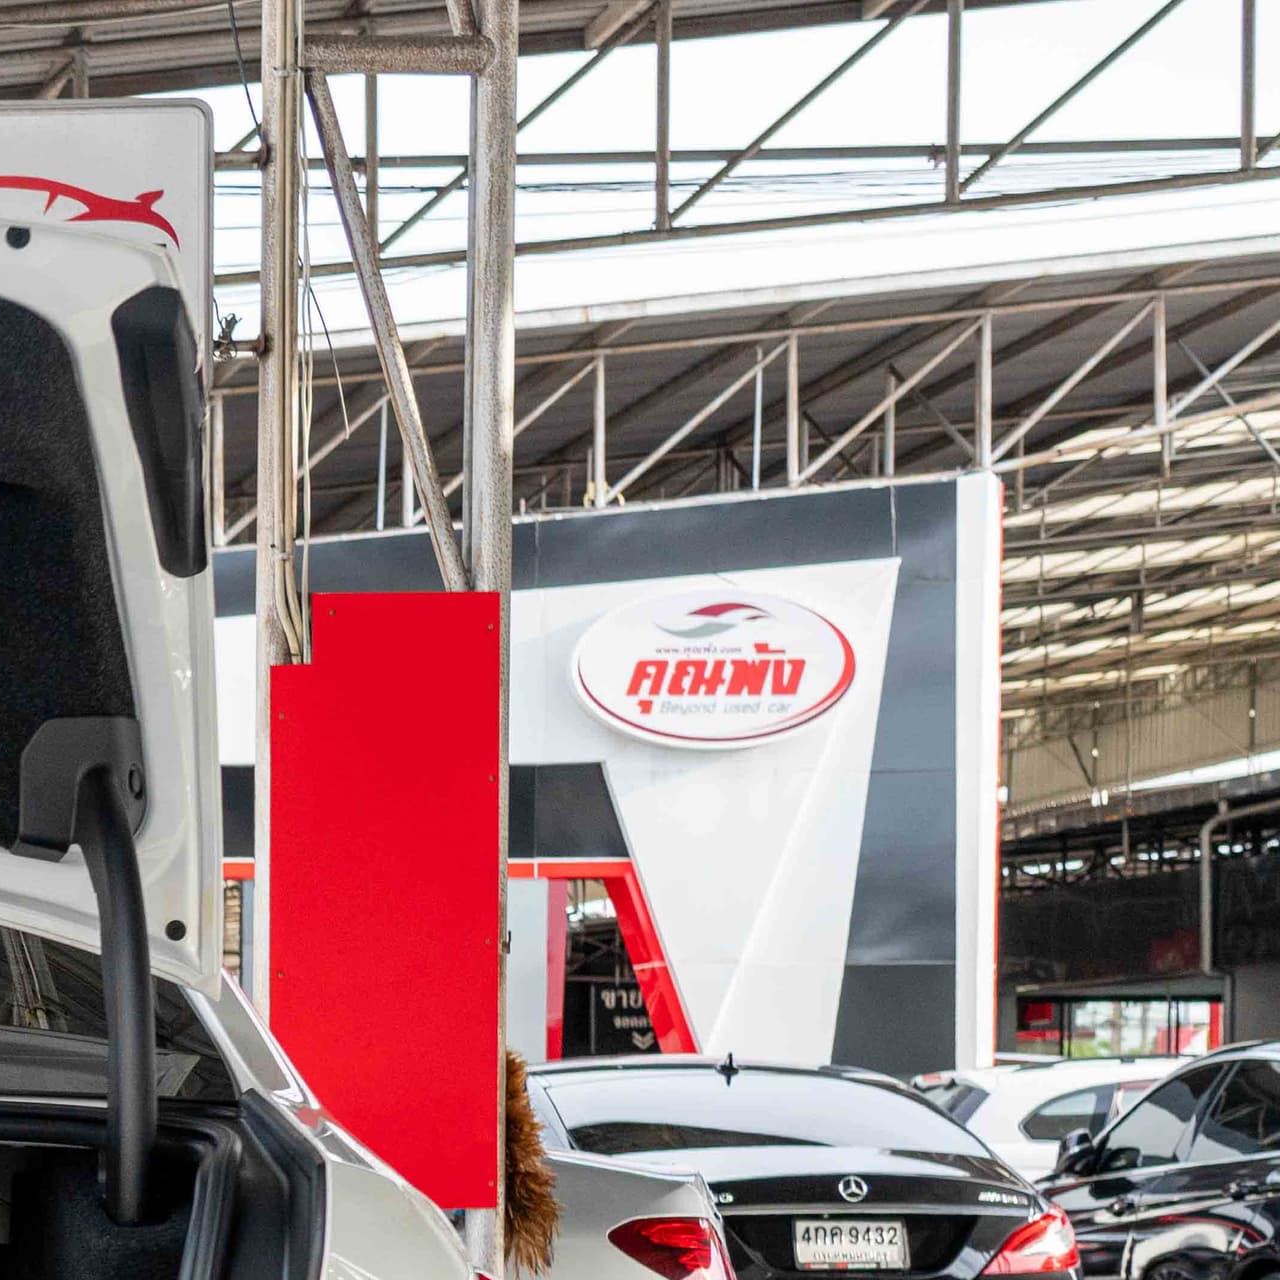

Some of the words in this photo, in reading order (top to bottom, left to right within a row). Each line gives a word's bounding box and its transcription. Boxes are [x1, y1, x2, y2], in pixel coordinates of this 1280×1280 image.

[660, 700, 717, 715] Beyond
[724, 700, 761, 714] used
[767, 702, 792, 714] car
[849, 1225, 899, 1246] 9432
